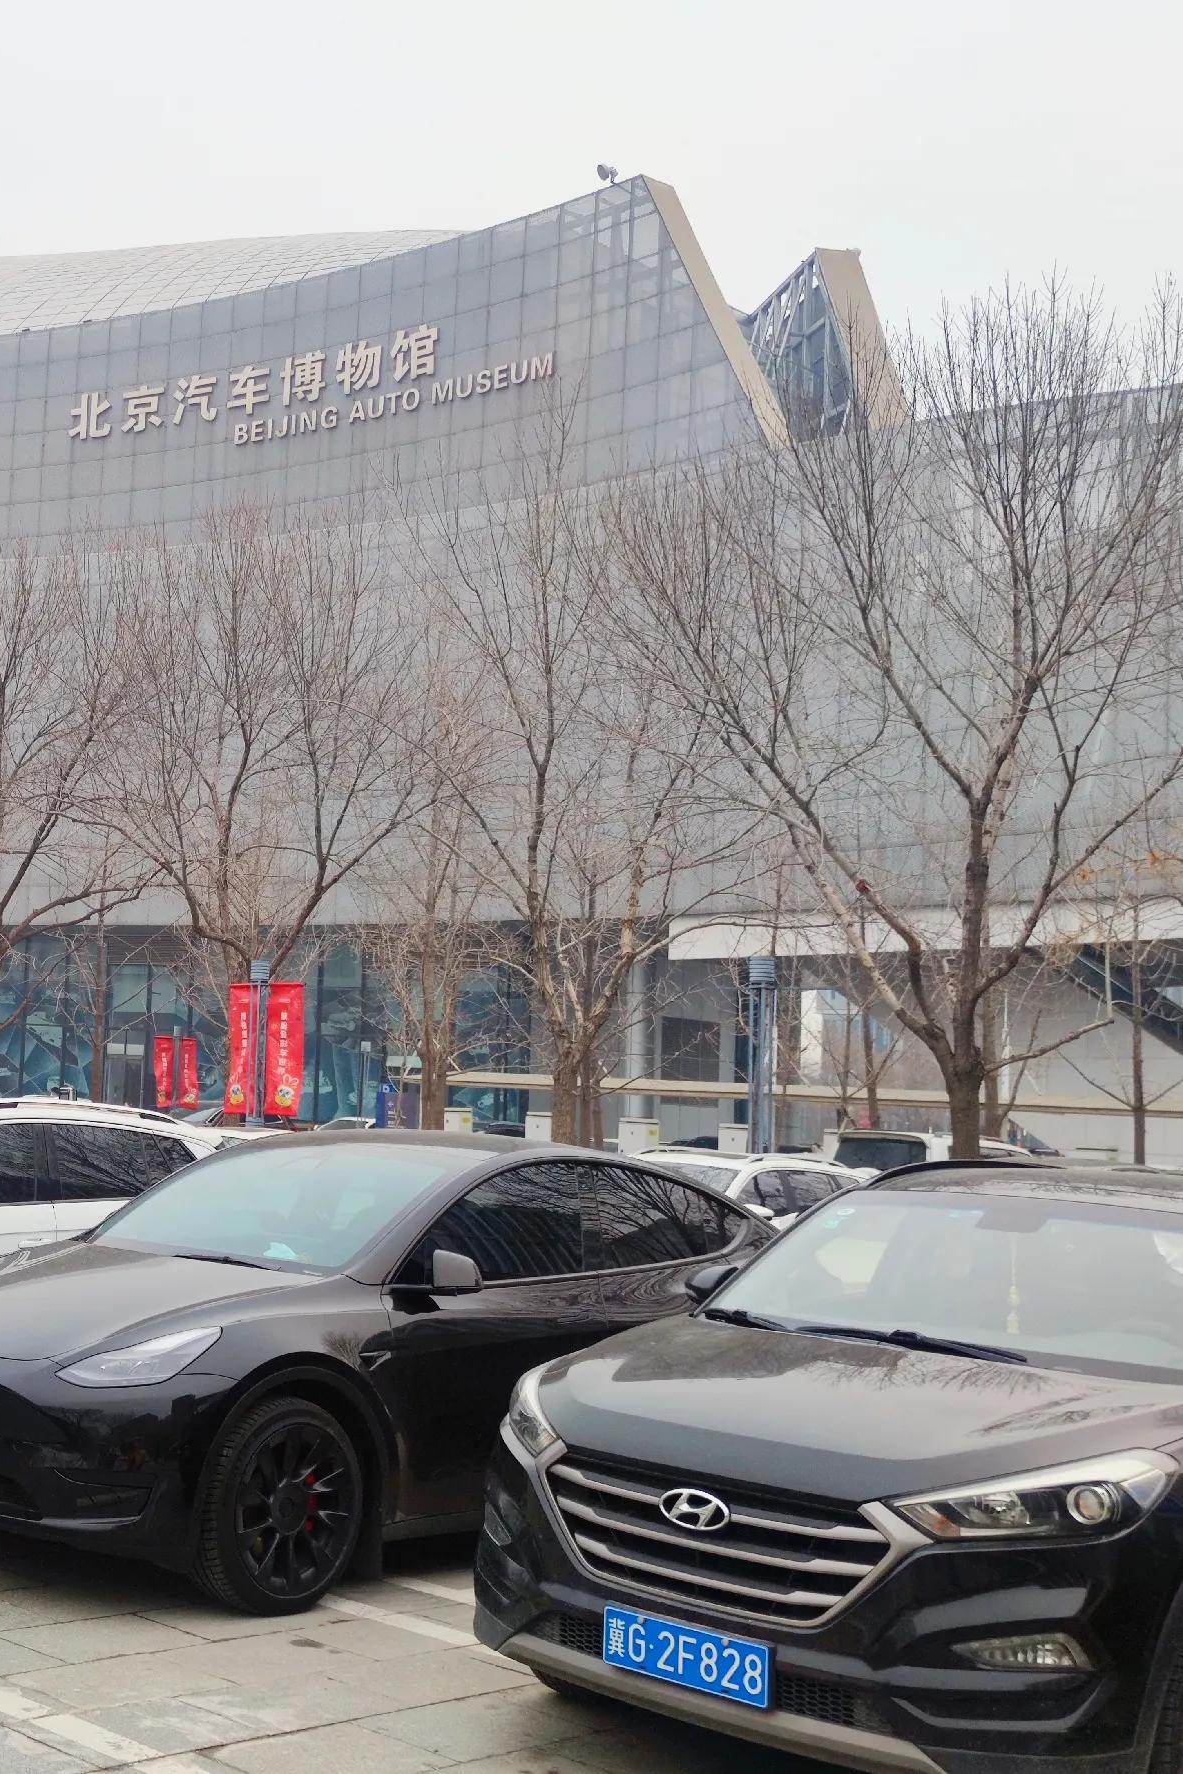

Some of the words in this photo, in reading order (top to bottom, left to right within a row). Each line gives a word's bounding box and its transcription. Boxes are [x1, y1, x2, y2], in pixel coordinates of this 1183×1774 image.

[68, 323, 441, 441] 北京汽车博物馆
[233, 407, 338, 446] BEIJING
[349, 389, 421, 425] AUTO
[431, 352, 555, 405] MUSEUM
